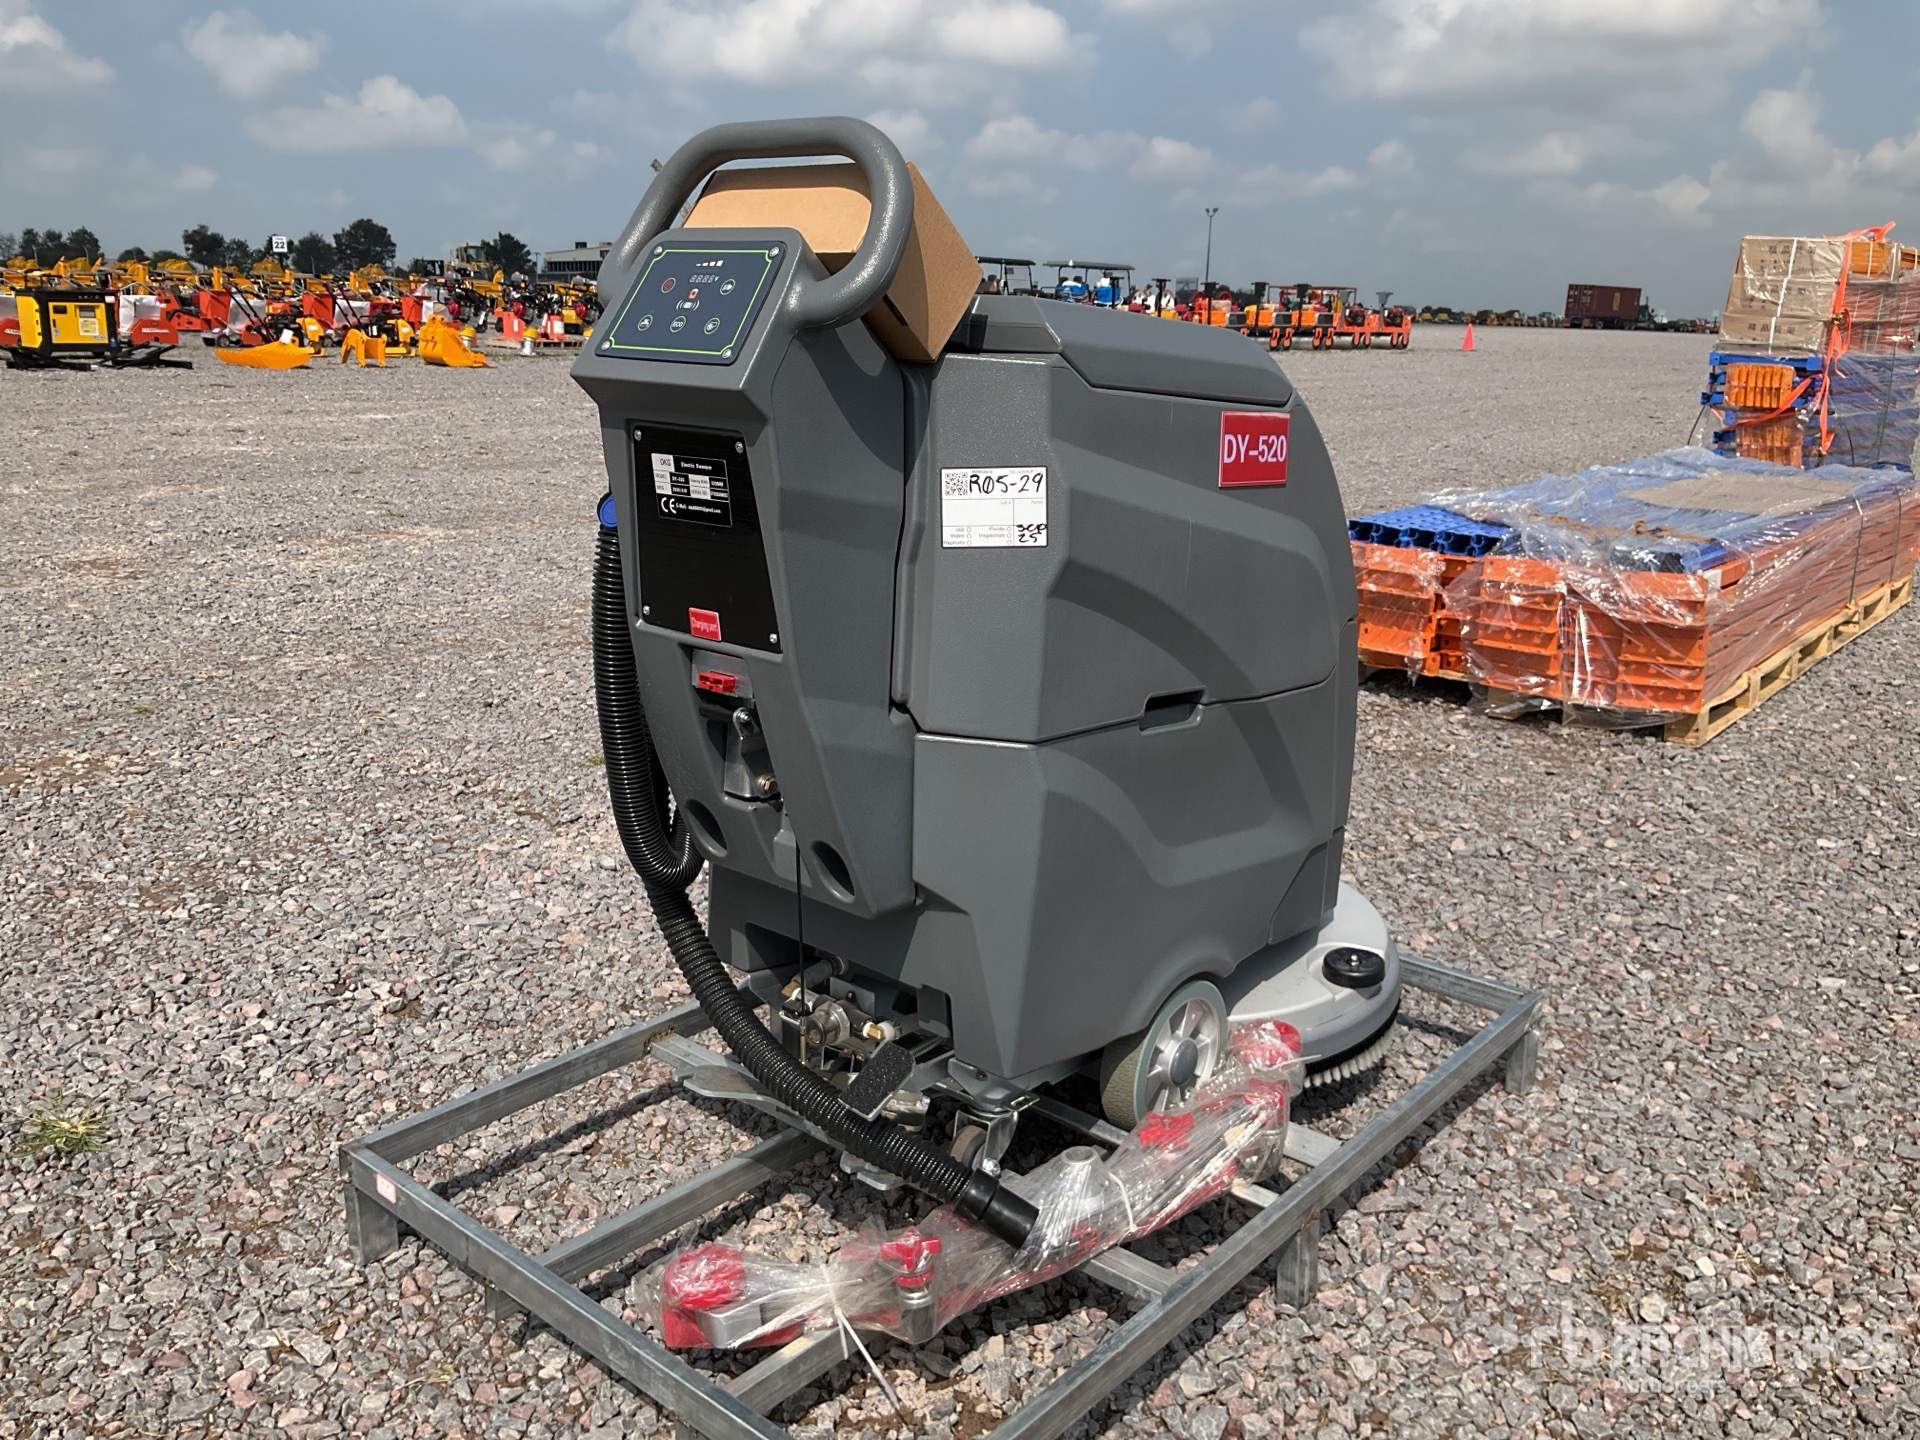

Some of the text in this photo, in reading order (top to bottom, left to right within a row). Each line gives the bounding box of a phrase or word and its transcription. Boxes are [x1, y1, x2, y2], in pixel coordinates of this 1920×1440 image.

[274, 241, 286, 249] 22
[1223, 433, 1287, 463] DY-520
[661, 497, 676, 514] CE
[1018, 532, 1042, 543] 25
